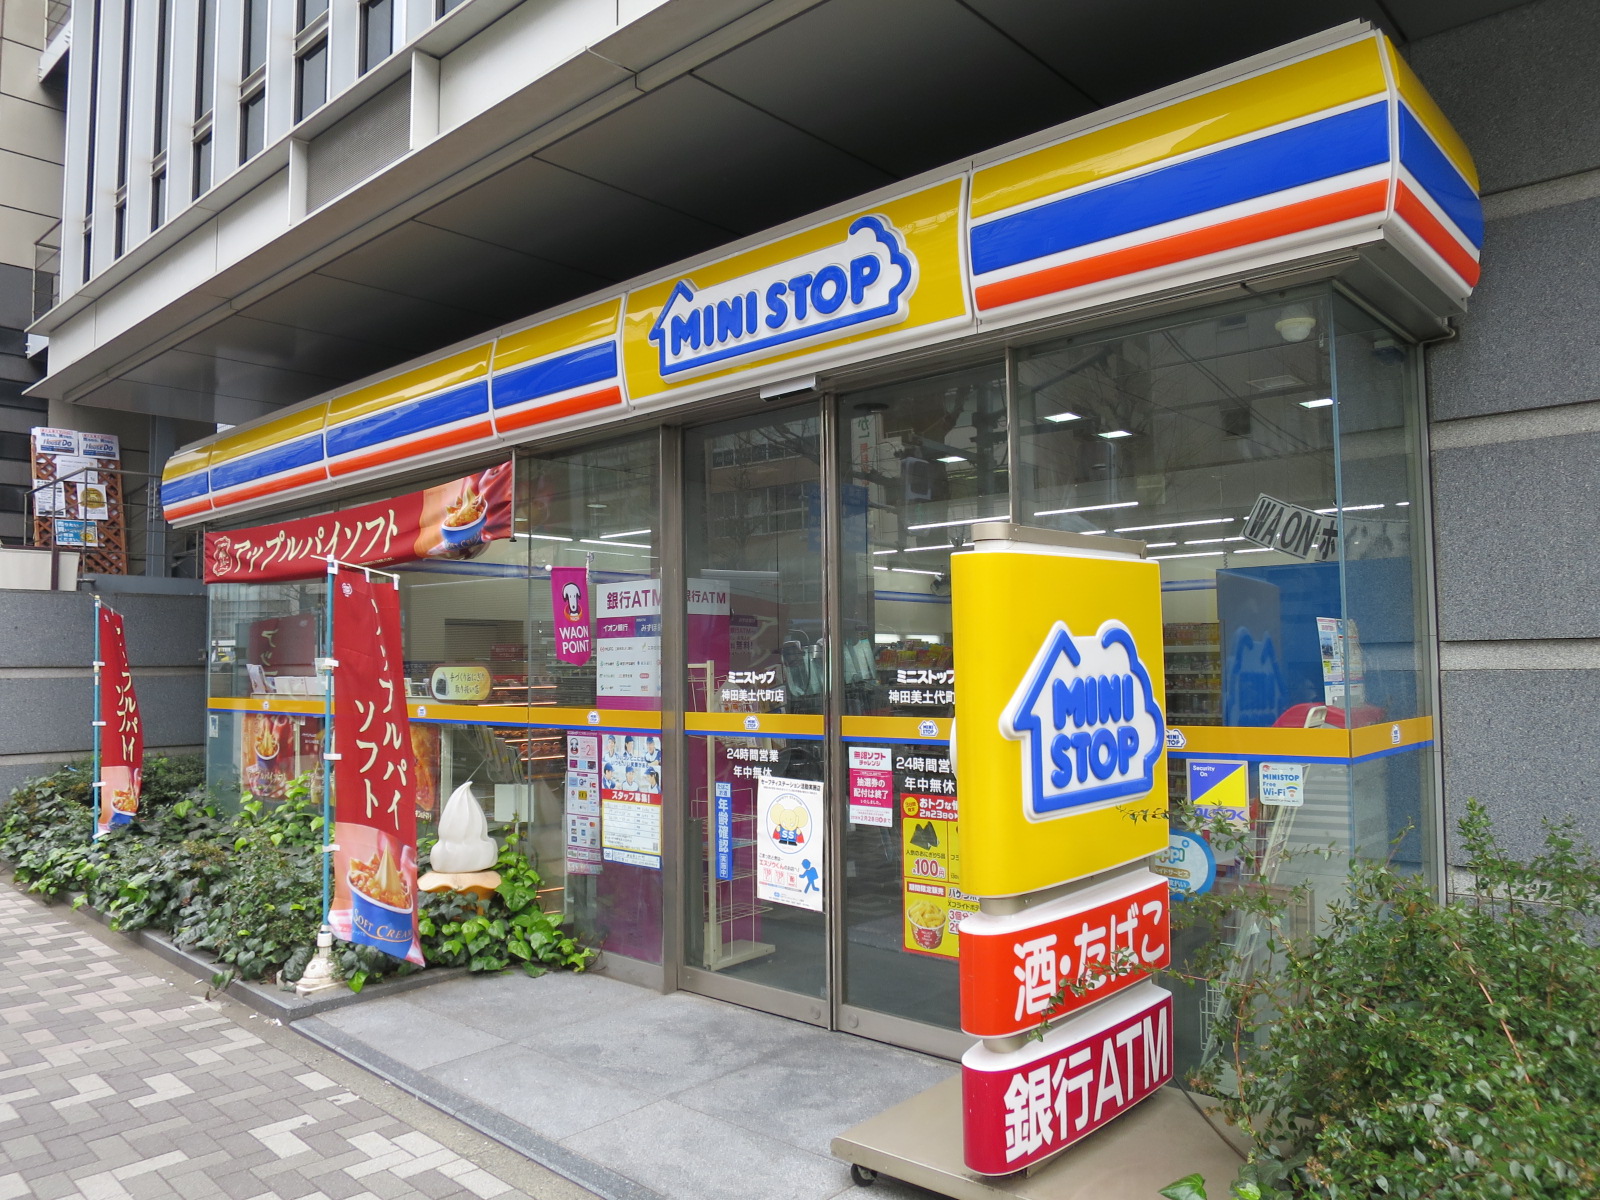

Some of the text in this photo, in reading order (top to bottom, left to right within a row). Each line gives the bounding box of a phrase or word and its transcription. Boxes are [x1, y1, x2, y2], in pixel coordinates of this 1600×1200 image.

[671, 254, 881, 357] MINI STOP
[233, 509, 398, 573] アップルパイソフト
[559, 625, 589, 640] WAON
[562, 640, 589, 655] POINT
[728, 671, 775, 684] ミニストップ
[721, 689, 784, 702] 神田美土代町店
[1053, 673, 1134, 731] MINI
[355, 700, 379, 819] ソフト
[726, 748, 779, 762] 24時間営業
[1051, 726, 1139, 790] STOP
[733, 765, 773, 779] 年中無休
[896, 757, 952, 774] 24時間営
[904, 777, 955, 794] 年中無休
[1263, 788, 1286, 796] Wi-Fi
[718, 798, 729, 853] 年齢確認
[782, 830, 795, 839] SS
[353, 908, 374, 932] SOFT
[1013, 900, 1165, 1021] 酒・たばこ
[1003, 1006, 1168, 1163] 銀行ATM
